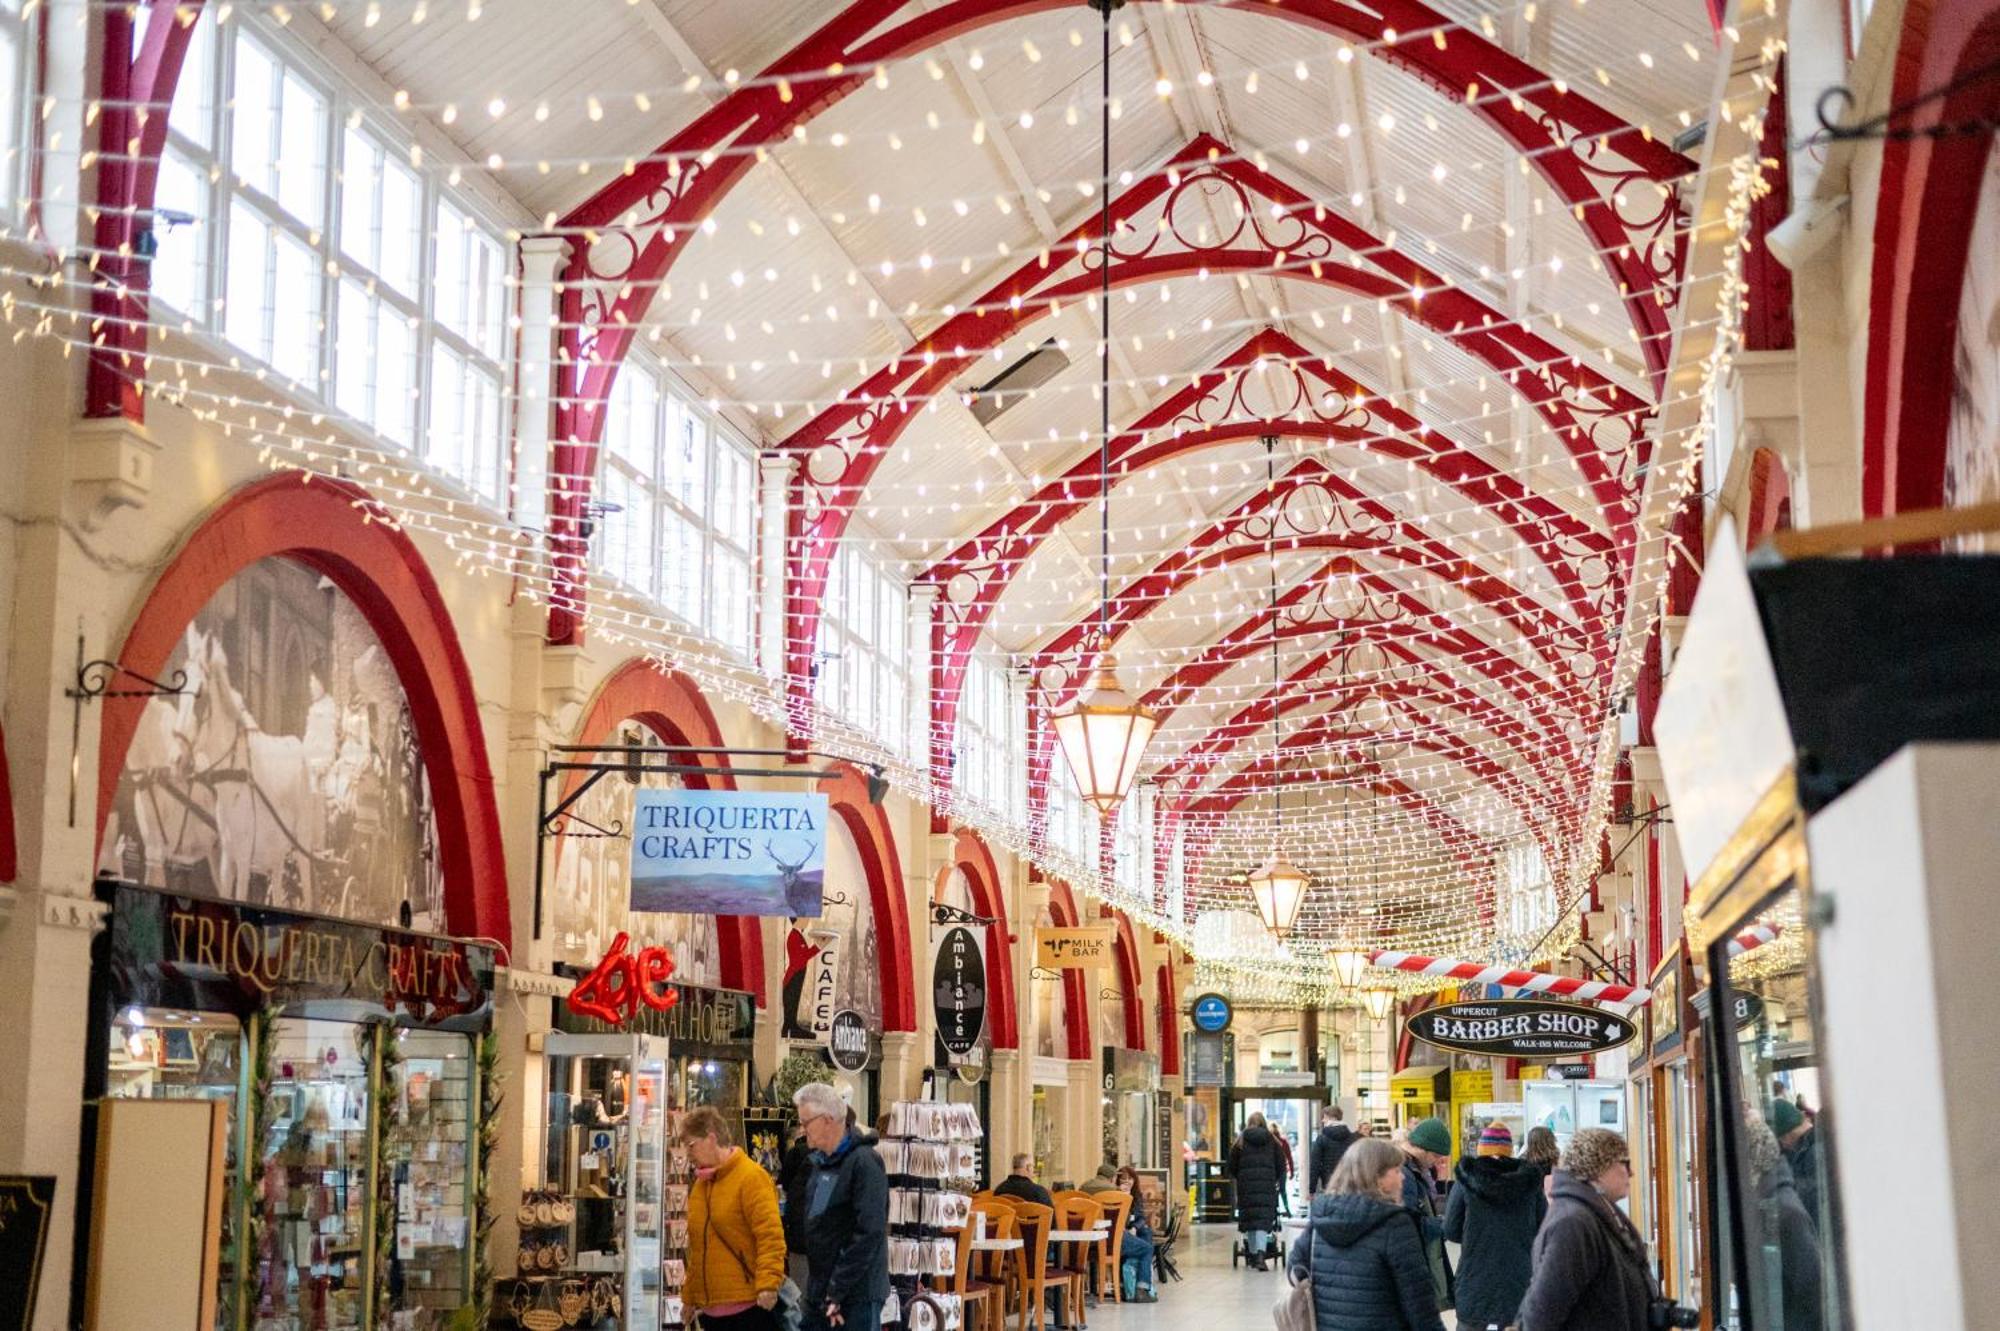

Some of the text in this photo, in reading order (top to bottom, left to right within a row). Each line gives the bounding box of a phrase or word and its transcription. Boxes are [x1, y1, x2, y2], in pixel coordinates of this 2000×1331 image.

[643, 805, 816, 834] TRIQUERTA
[641, 836, 753, 860] CRAFTS
[171, 912, 462, 999] TRIQUERTA CRAFTS
[1072, 939, 1104, 948] MILK
[1072, 948, 1100, 957] BAR
[816, 951, 835, 1019] CAFE
[953, 930, 965, 1036] Ambiance
[1451, 1007, 1498, 1016] UPPERCUT
[1432, 1013, 1600, 1040] BARBER SHOP
[1513, 1039, 1592, 1049] WALK-INS WELCOME
[1105, 1073, 1114, 1089] 6
